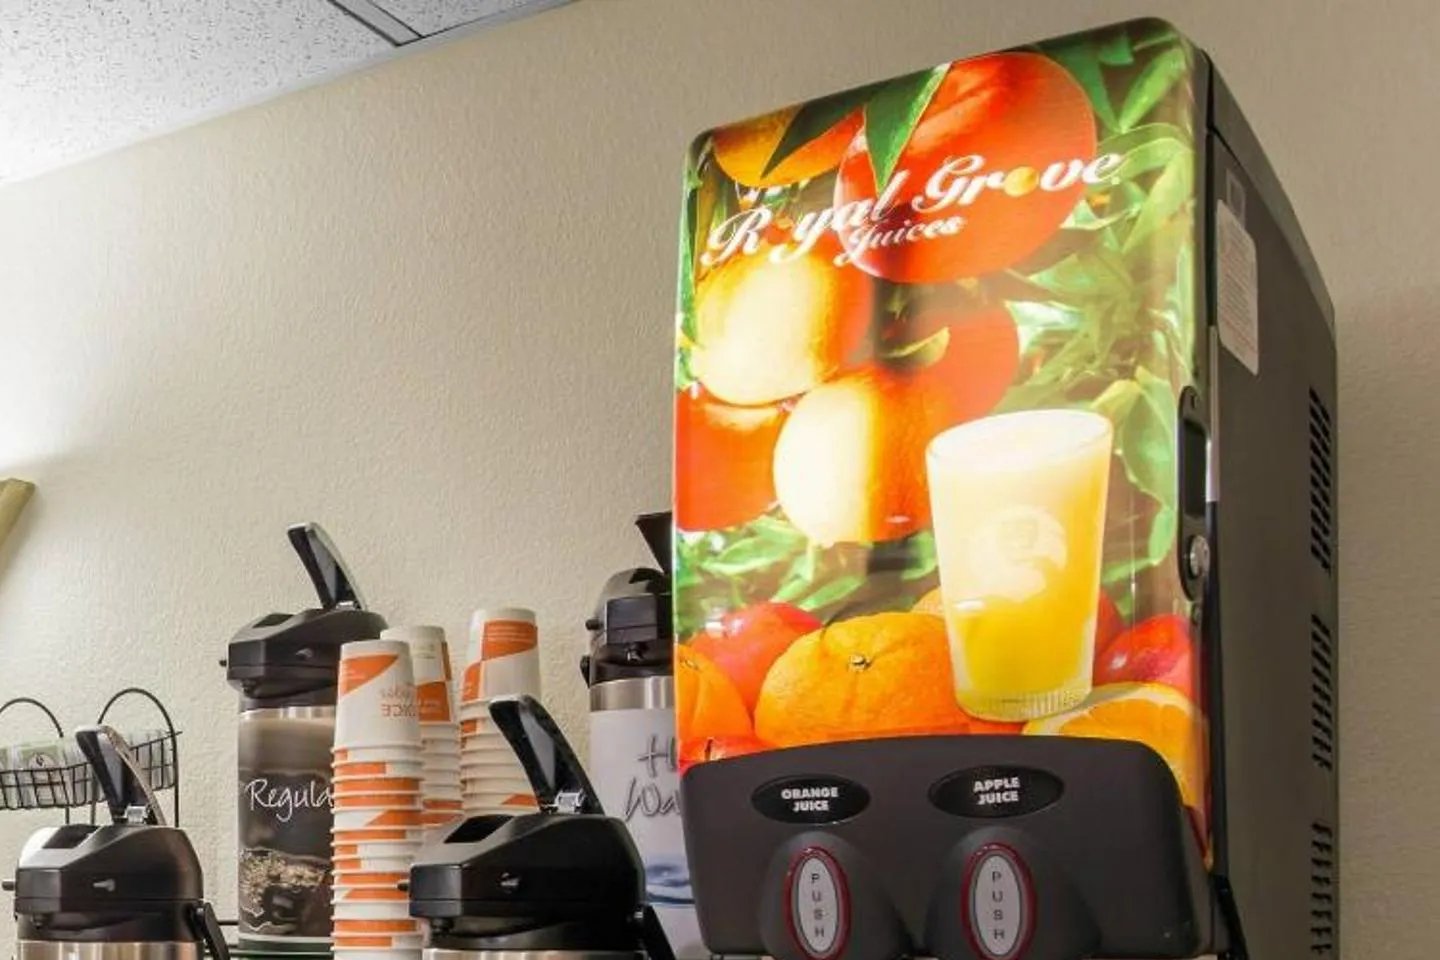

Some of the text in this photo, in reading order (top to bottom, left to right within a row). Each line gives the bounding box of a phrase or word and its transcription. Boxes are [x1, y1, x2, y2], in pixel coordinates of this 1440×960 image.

[911, 152, 1124, 213] Grove
[833, 215, 964, 268] Juices
[244, 778, 334, 822] Regula
[780, 786, 839, 800] ORANGE
[792, 800, 830, 813] JUICE
[973, 776, 1021, 793] APPLE
[976, 790, 1020, 805] JUICE
[811, 872, 825, 938] PUSH
[991, 870, 1006, 940] PUSH
